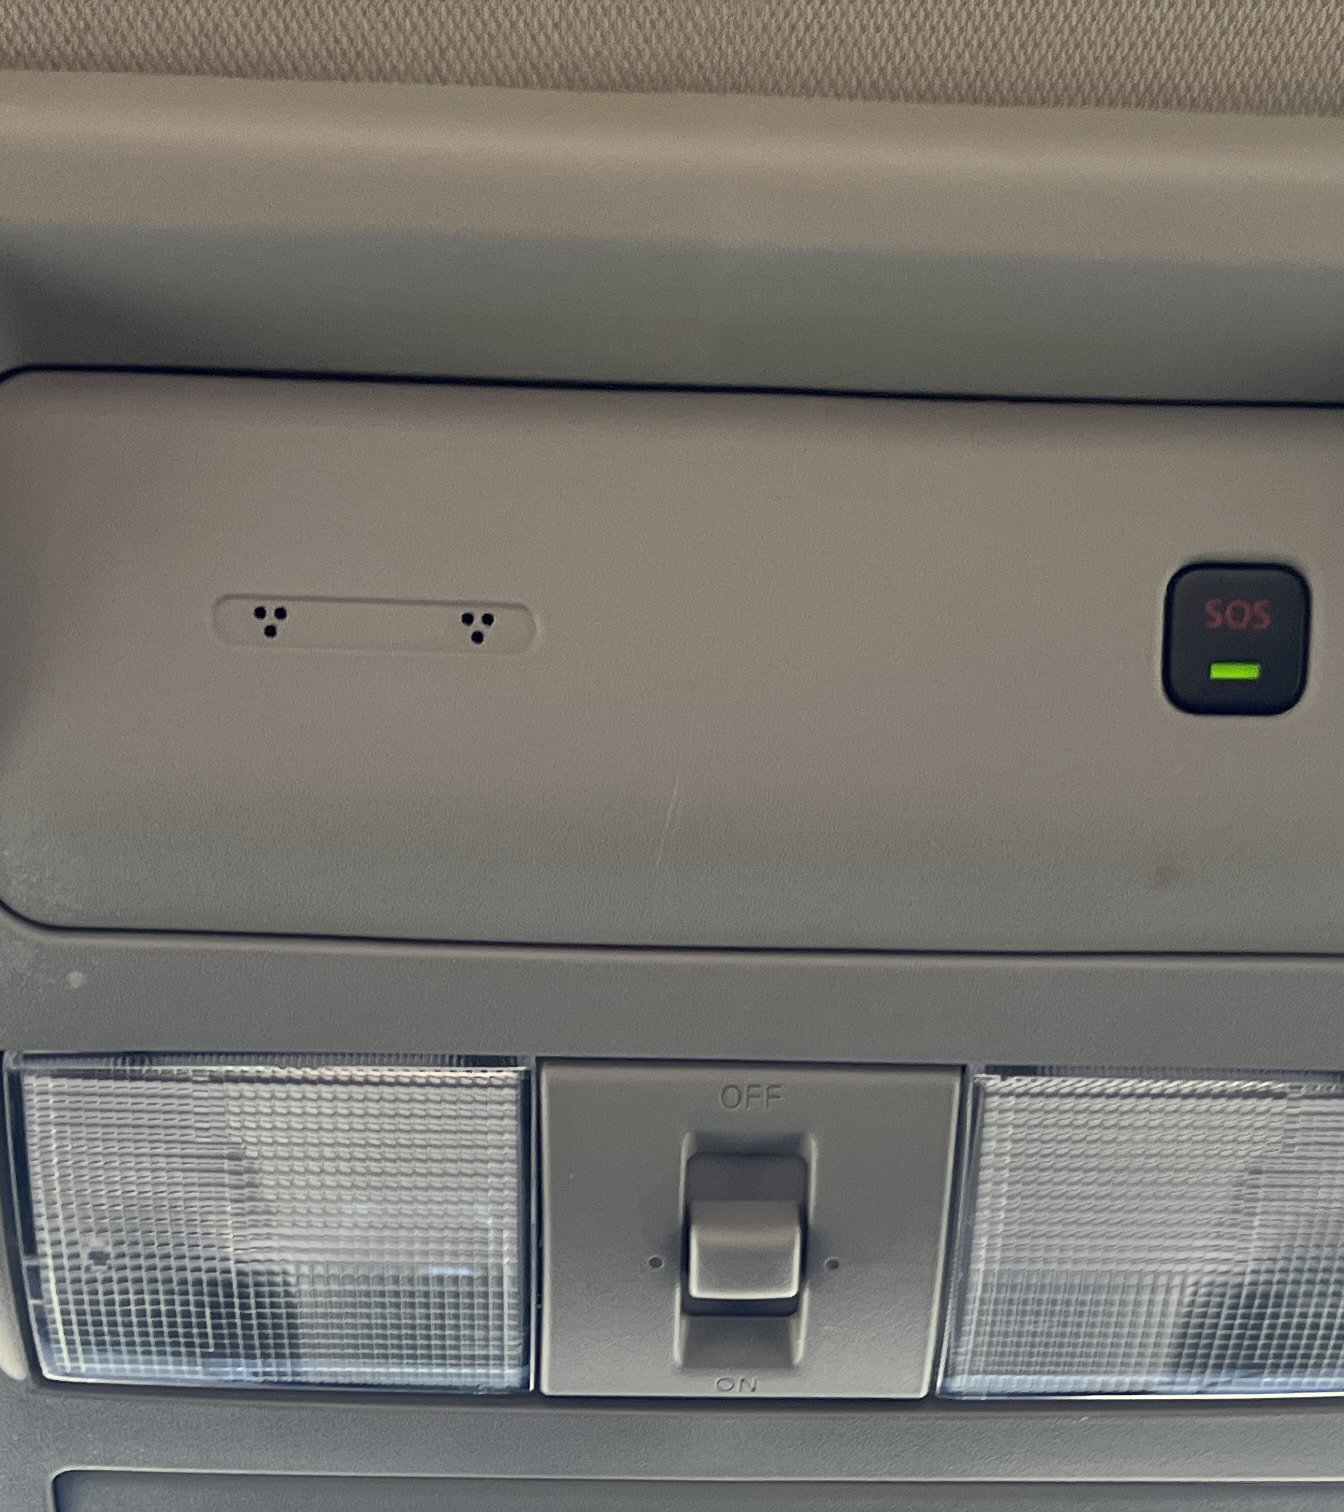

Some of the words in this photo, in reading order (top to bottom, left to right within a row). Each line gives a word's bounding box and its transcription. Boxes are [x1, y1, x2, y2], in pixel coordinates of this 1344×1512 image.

[1205, 598, 1272, 630] SOS
[719, 1084, 784, 1110] OFF
[716, 1376, 757, 1393] ON
